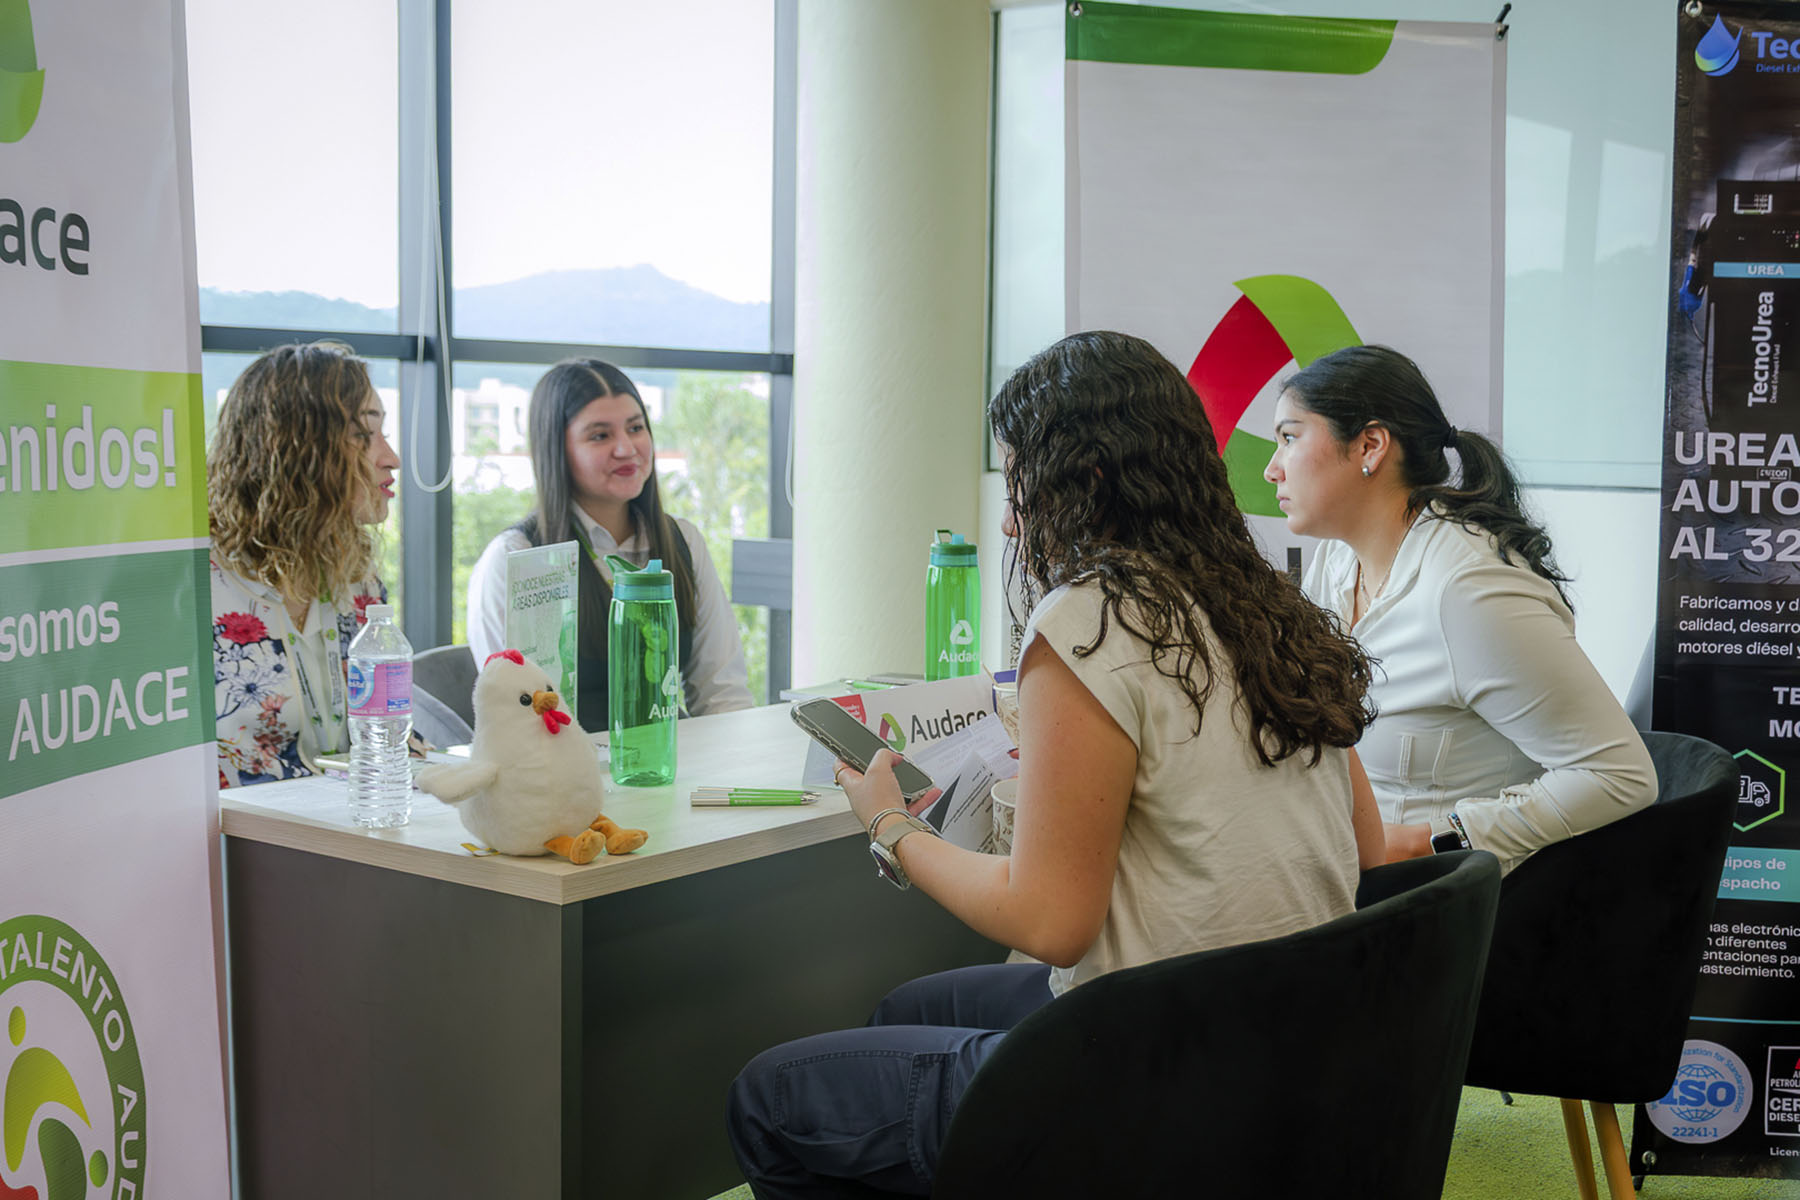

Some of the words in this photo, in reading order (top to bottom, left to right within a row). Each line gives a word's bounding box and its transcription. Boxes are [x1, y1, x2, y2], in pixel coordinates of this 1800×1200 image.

[0, 198, 90, 275] ace
[1748, 265, 1784, 275] UREA
[1747, 291, 1775, 407] TecnoUrea
[0, 404, 176, 492] nidos!
[1675, 431, 1800, 467] UREA
[1671, 479, 1800, 515] AUTO
[1669, 526, 1729, 560] AL
[1679, 595, 1772, 611] Fabricamos
[1776, 600, 1785, 614] y
[0, 601, 120, 662] somos
[1679, 617, 1736, 634] calidad,
[1739, 619, 1800, 634] desarro
[1678, 641, 1743, 655] motores
[1746, 641, 1793, 656] diésel
[1773, 687, 1800, 705] TE
[8, 666, 189, 762] AUDACE
[1765, 858, 1786, 870] de
[1720, 877, 1781, 891] spacho
[1709, 923, 1729, 934] as
[1731, 922, 1800, 937] electrónic
[1715, 935, 1787, 950] diferentes
[1699, 964, 1796, 978] astecimiento.
[1770, 1078, 1800, 1088] PETROL
[1672, 1126, 1719, 1138] 22241-1
[1770, 1146, 1800, 1157] Licen
